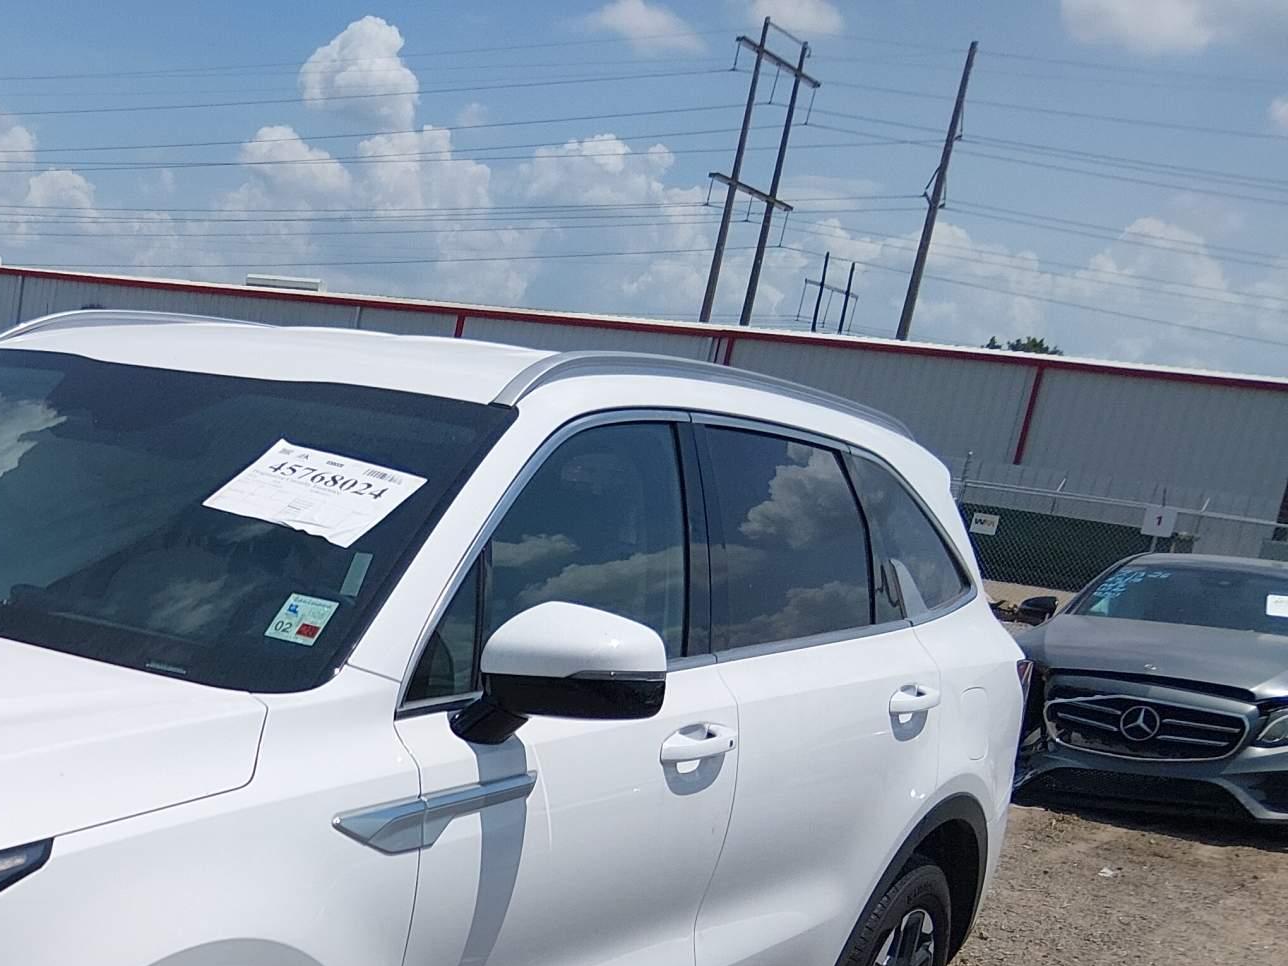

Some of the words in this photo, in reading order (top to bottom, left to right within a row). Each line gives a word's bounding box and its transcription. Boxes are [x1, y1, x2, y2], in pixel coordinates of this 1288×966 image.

[268, 461, 390, 500] 45768024
[1156, 515, 1163, 526] 1
[274, 620, 293, 633] 02
